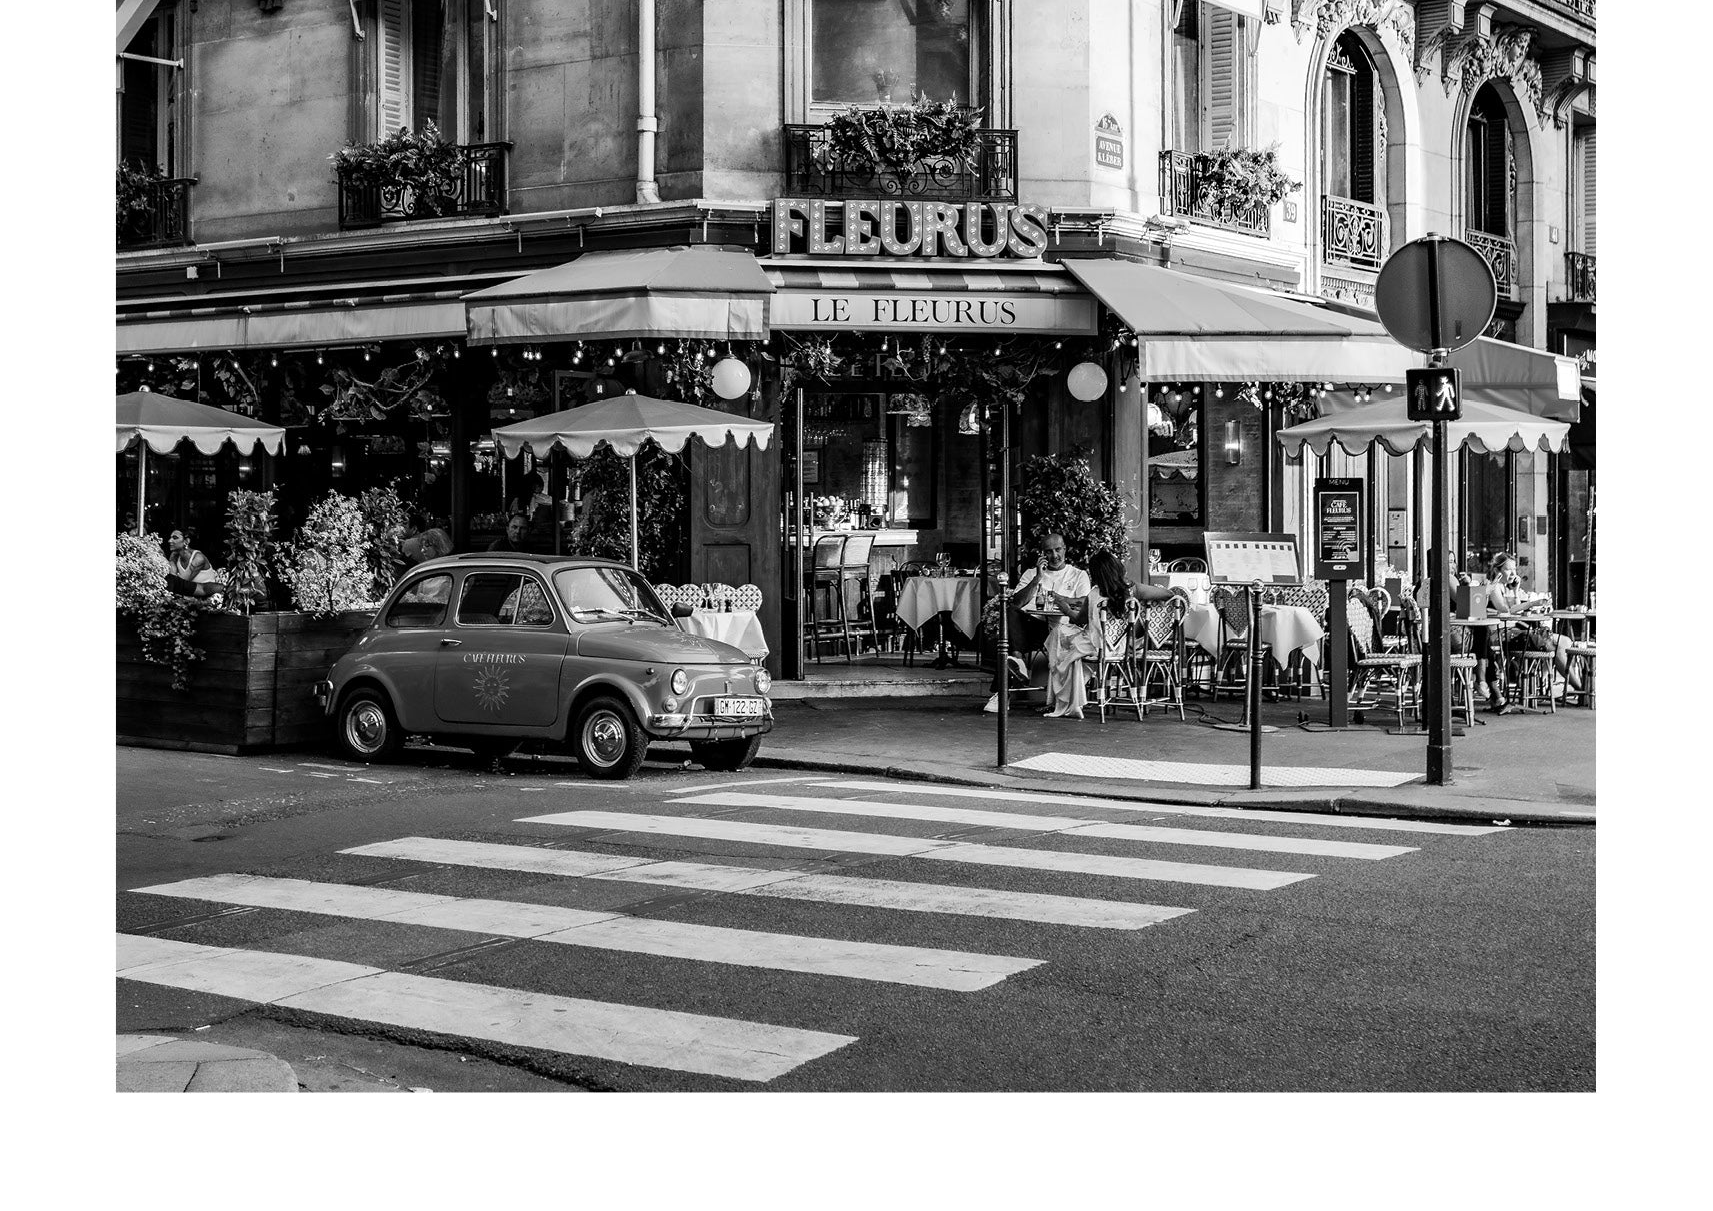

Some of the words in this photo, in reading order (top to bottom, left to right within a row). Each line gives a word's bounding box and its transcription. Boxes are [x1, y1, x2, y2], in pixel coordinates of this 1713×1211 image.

[1099, 140, 1121, 154] AVENUE
[1097, 152, 1122, 167] KLÉBER
[1286, 203, 1296, 220] 39
[773, 198, 1048, 258] FLEURUS
[811, 298, 850, 322] LE
[872, 298, 1017, 325] FLEURUS
